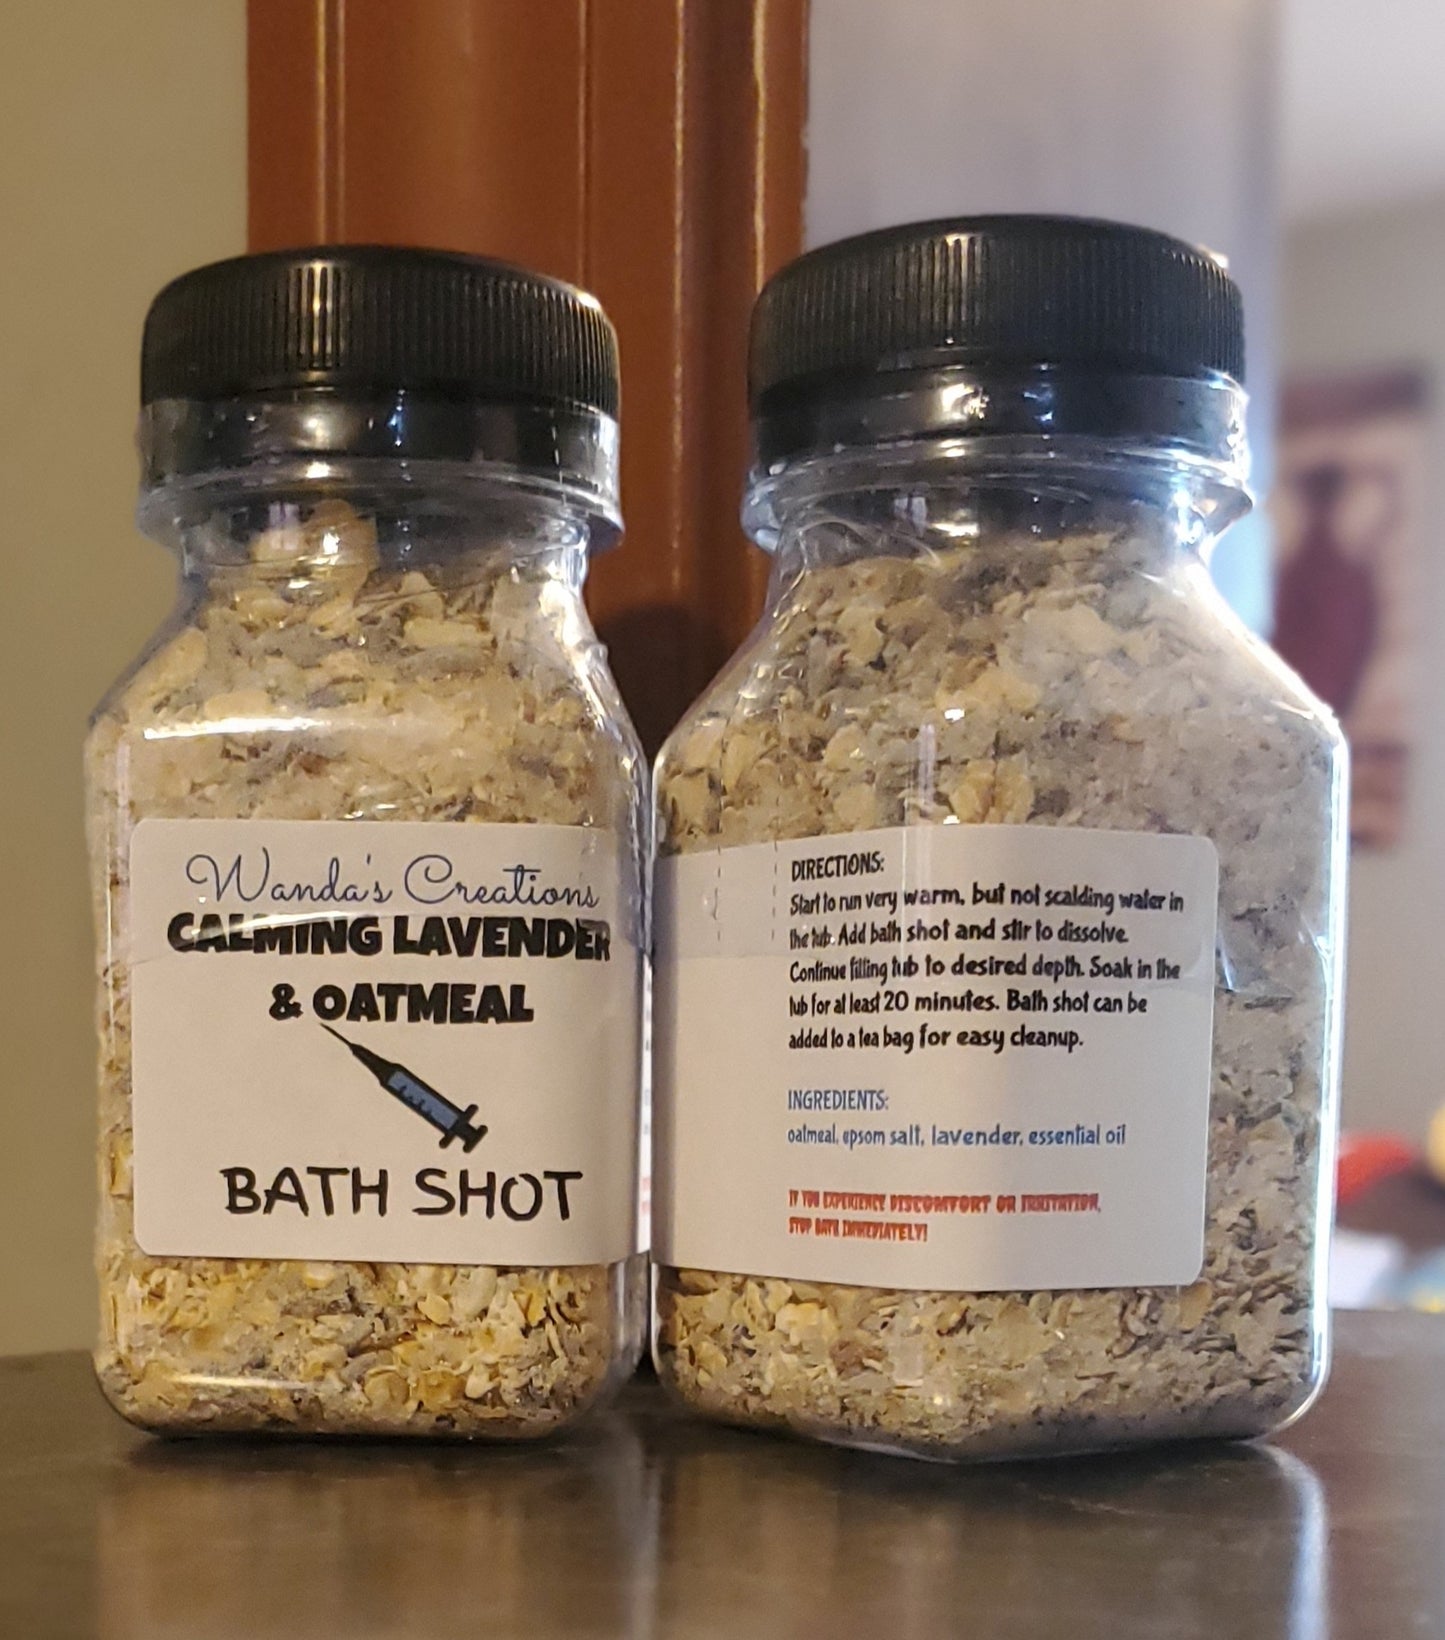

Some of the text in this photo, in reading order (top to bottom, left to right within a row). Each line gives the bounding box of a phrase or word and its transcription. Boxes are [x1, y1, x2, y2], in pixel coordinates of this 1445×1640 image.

[186, 847, 600, 908] Wanda's Creations
[791, 851, 885, 882] DIRECTIONS:
[790, 891, 821, 916] Start
[823, 890, 836, 913] to
[839, 893, 862, 912] run
[864, 890, 898, 915] very
[972, 881, 1006, 905] but
[1011, 884, 1040, 906] not
[1044, 885, 1115, 916] scalding
[1118, 888, 1166, 911] water
[1169, 891, 1184, 913] in
[167, 911, 611, 961] CALMING LAVENDER
[838, 922, 867, 946] Add
[870, 919, 901, 945] bath
[906, 918, 950, 943] shot
[954, 916, 996, 941] and
[1001, 917, 1032, 941] stir
[1035, 918, 1053, 942] to
[790, 953, 1181, 986] Continue filling tub to desired depth. Soak in the
[269, 982, 534, 1024] & OATMEAL
[789, 988, 1148, 1017] tub for at least 20 minutes. Bath shot can be
[788, 1022, 1084, 1055] added to a tea bag for easy cleanup.
[787, 1089, 889, 1111] INGREDIENTS:
[842, 1128, 886, 1150] epsom
[1028, 1124, 1101, 1146] essential
[1105, 1124, 1127, 1145] oil
[220, 1167, 583, 1221] BATH SHOT
[822, 1191, 887, 1212] EXPERIENCE
[889, 1194, 992, 1214] DISCOMFORT
[995, 1194, 1016, 1213] OR
